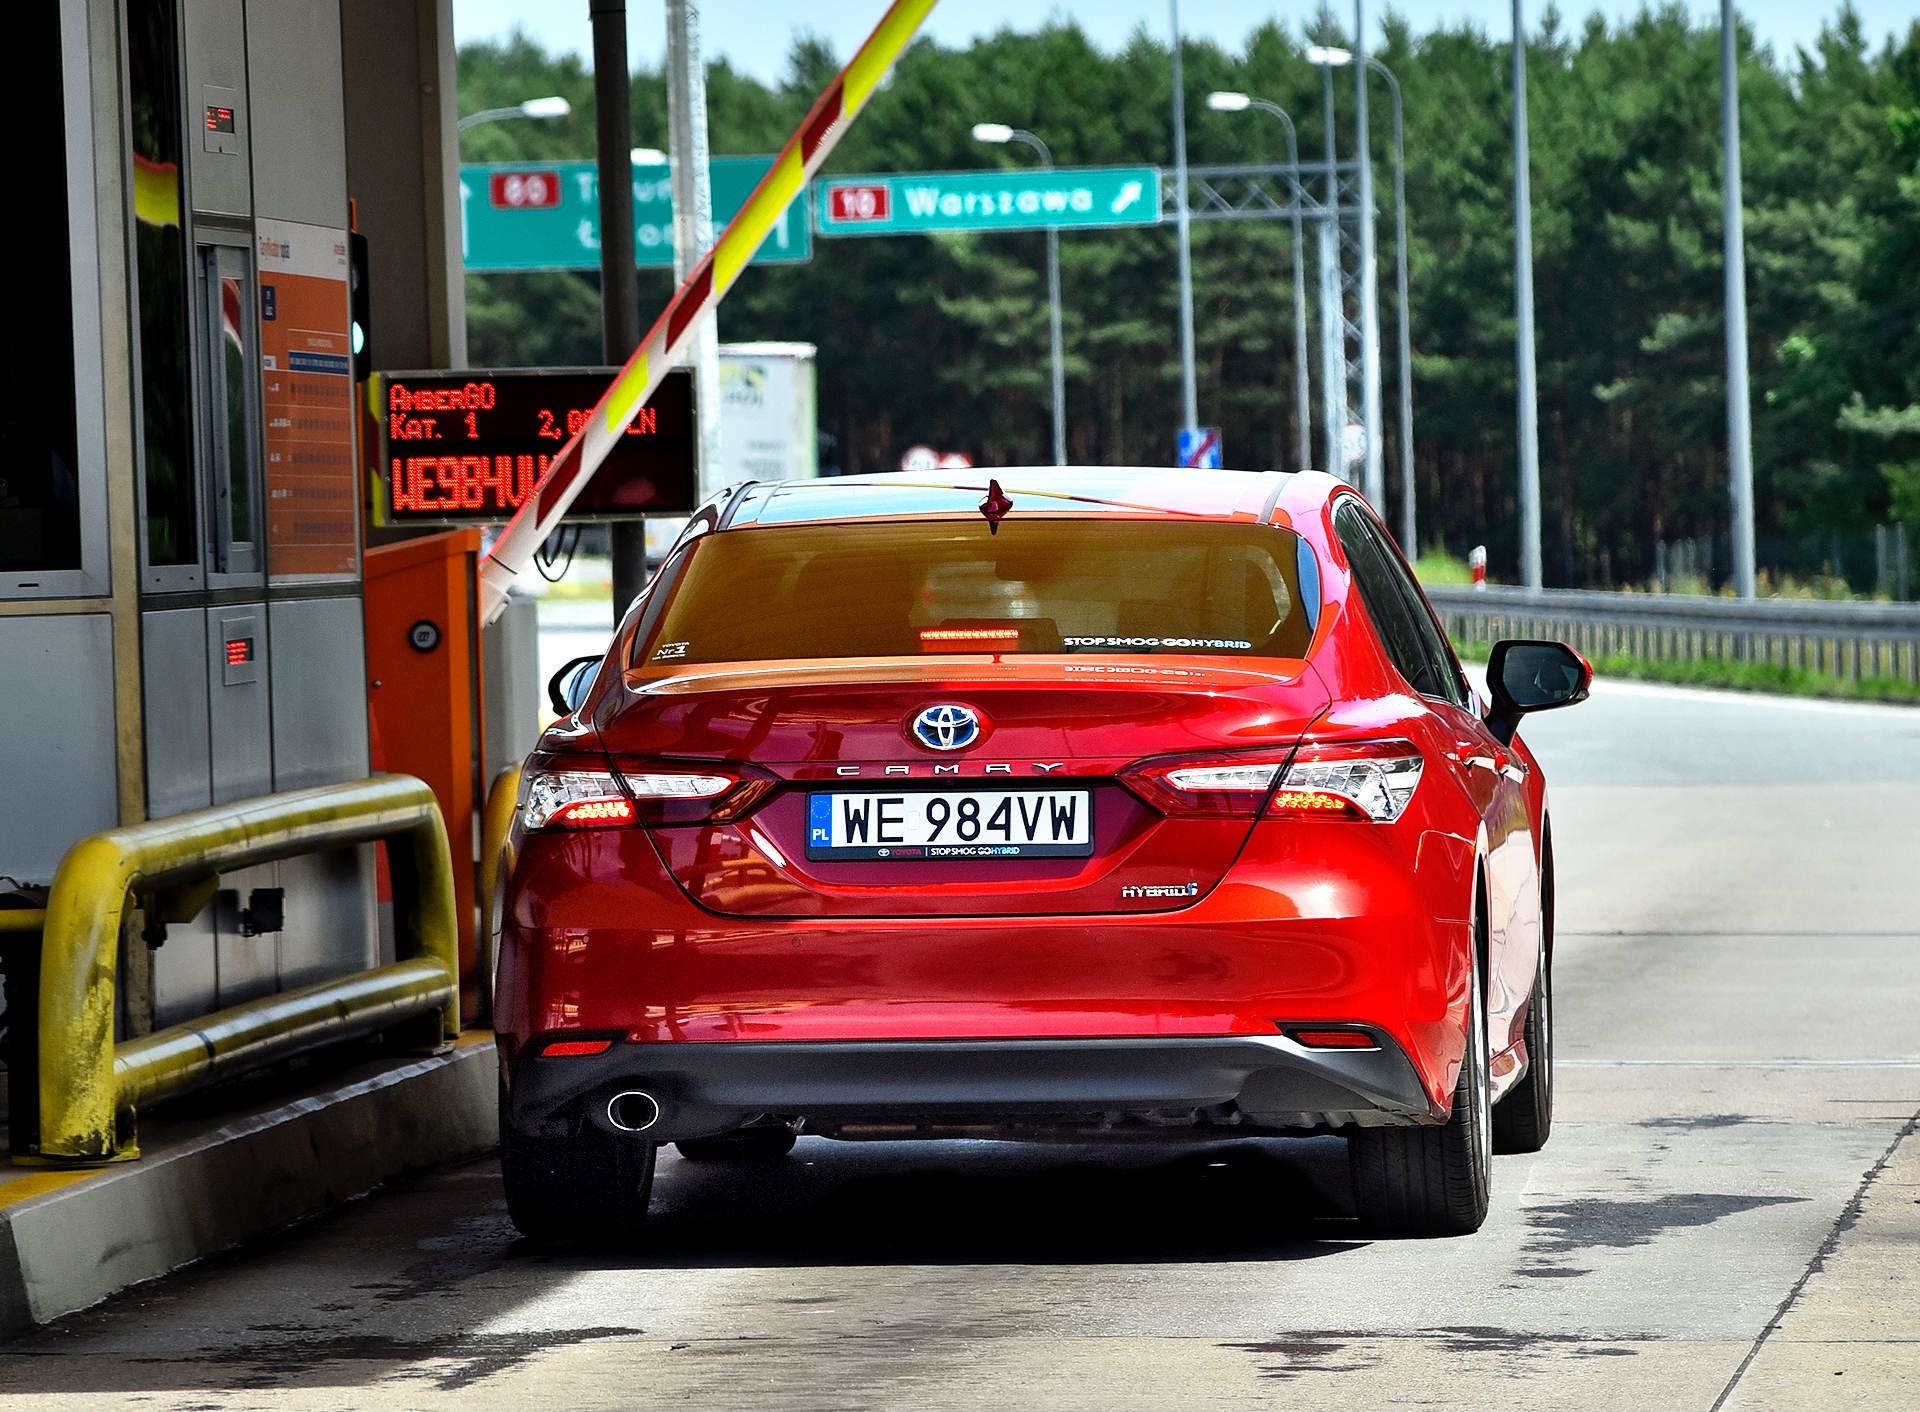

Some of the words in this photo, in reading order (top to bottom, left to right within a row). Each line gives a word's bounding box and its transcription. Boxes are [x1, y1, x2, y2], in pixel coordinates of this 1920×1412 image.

[904, 186, 1093, 216] Warszawa
[464, 411, 479, 439] 1
[836, 762, 1065, 776] CAMRY
[812, 828, 829, 841] PL
[843, 797, 905, 844] WE
[926, 795, 1077, 842] 984VW
[891, 848, 922, 856] TOYOTA
[1122, 885, 1187, 898] HYBRID
